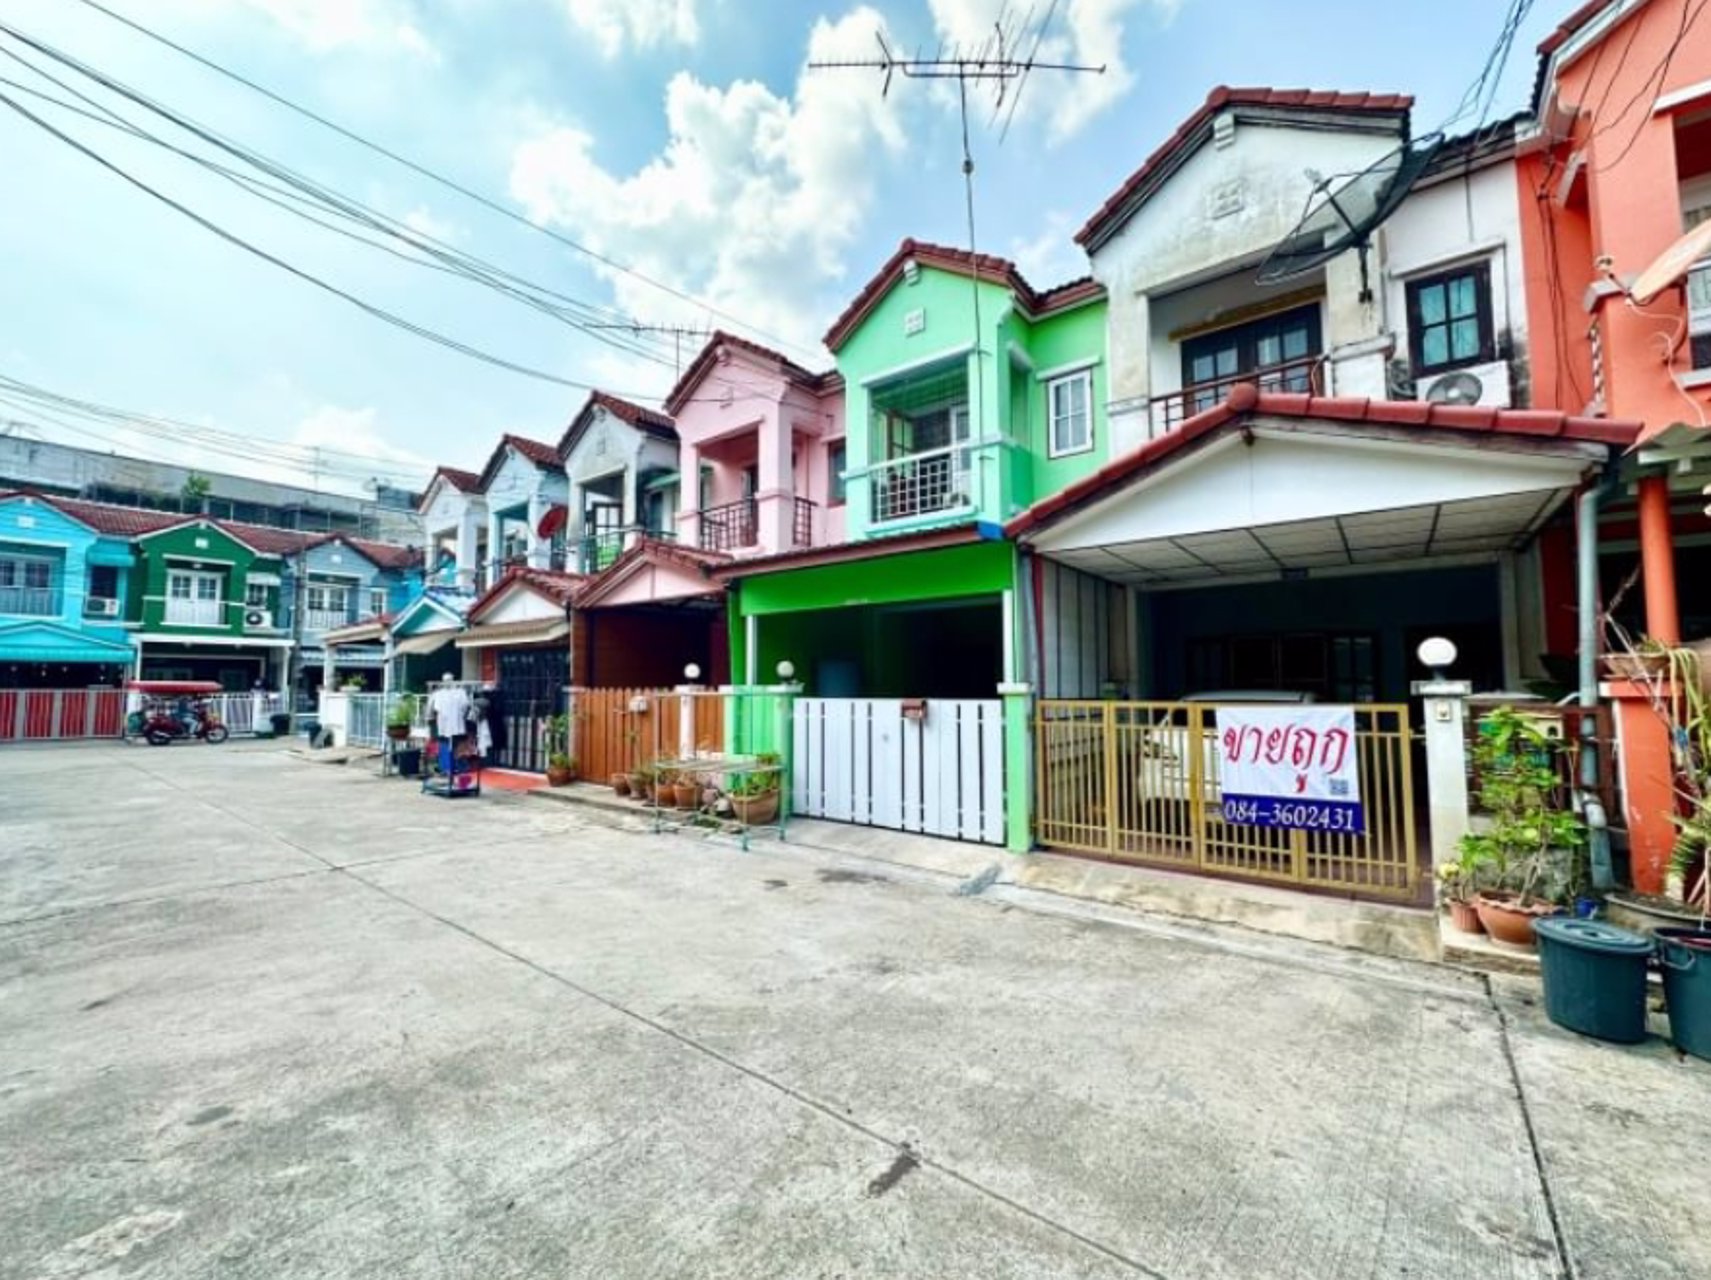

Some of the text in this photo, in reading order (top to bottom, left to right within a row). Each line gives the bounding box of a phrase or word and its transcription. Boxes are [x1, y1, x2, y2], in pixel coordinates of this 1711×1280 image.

[1223, 724, 1348, 793] ขายถูก
[1224, 799, 1354, 830] 084-3602431
